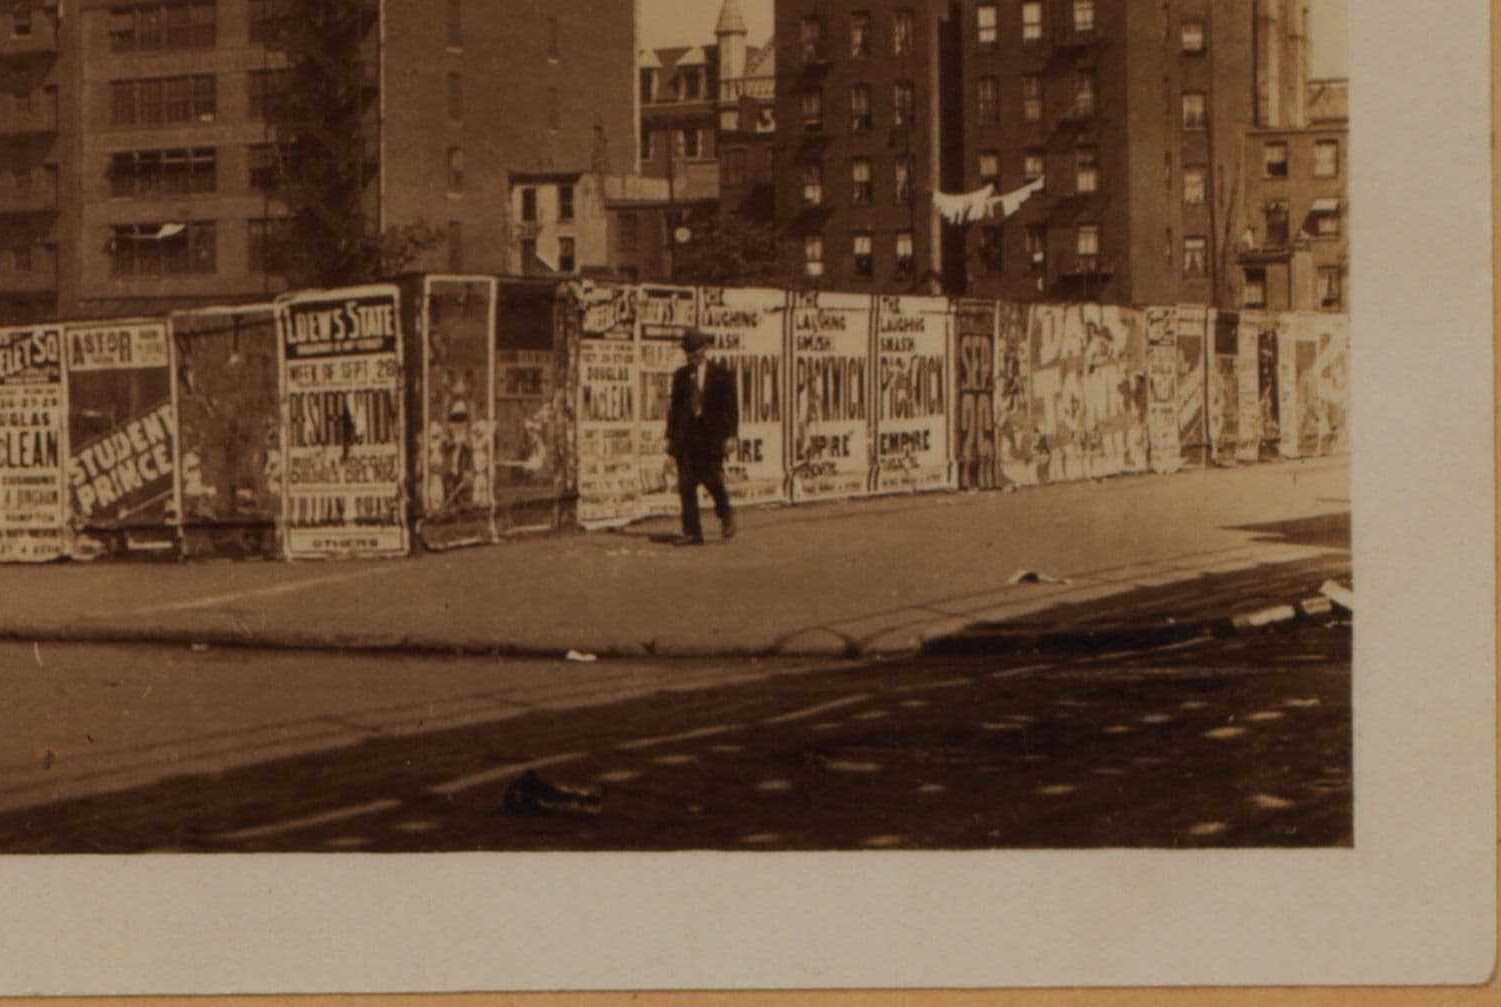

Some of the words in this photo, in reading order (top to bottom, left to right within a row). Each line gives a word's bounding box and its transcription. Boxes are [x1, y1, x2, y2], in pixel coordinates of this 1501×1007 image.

[345, 300, 396, 339] STATE
[702, 311, 759, 330] LAUGHING
[71, 332, 132, 365] ASTOR
[67, 402, 177, 486] STUDENT
[879, 429, 931, 455] EMPIRE
[75, 442, 174, 517] PRINCE
